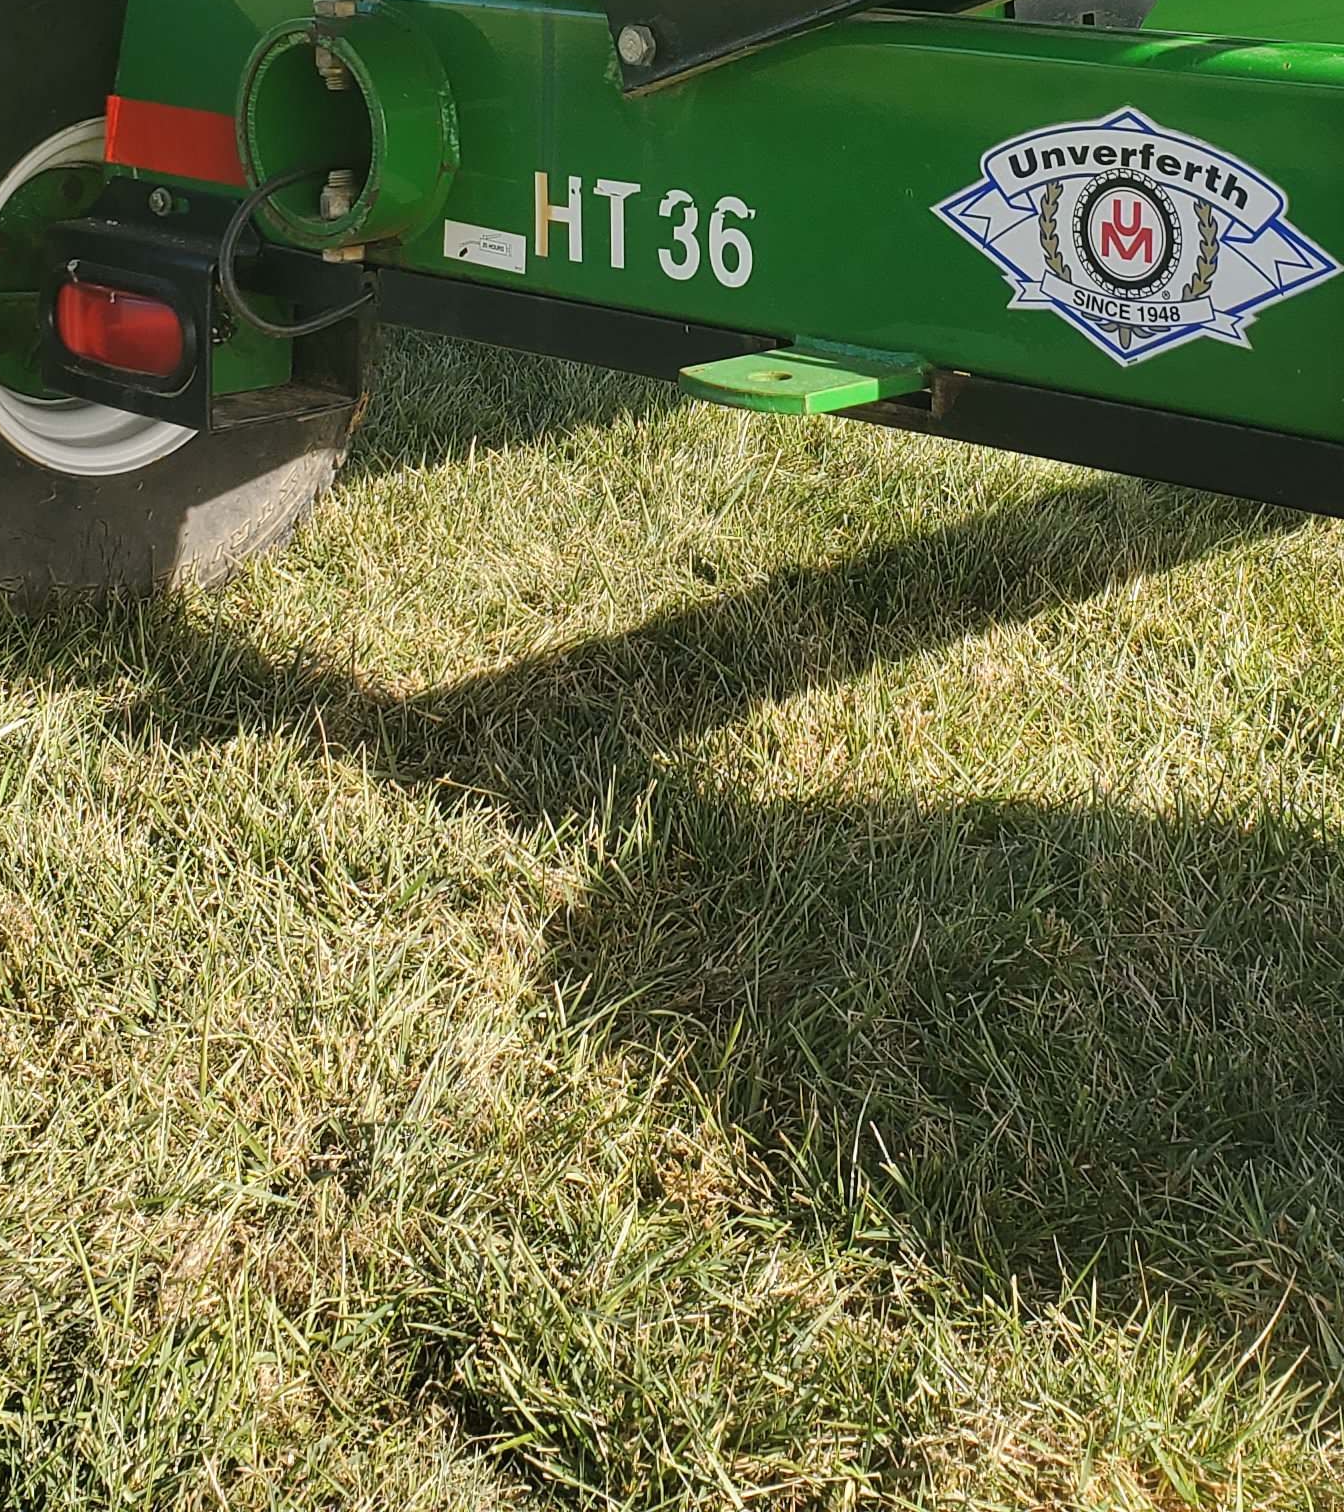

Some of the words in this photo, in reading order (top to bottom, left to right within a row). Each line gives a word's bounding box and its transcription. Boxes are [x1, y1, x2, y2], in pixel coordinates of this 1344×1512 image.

[1008, 143, 1249, 210] Unverferth
[534, 171, 641, 269] HT
[657, 189, 756, 289] 36
[1072, 289, 1131, 321] SINCE
[1136, 305, 1181, 323] 1948
